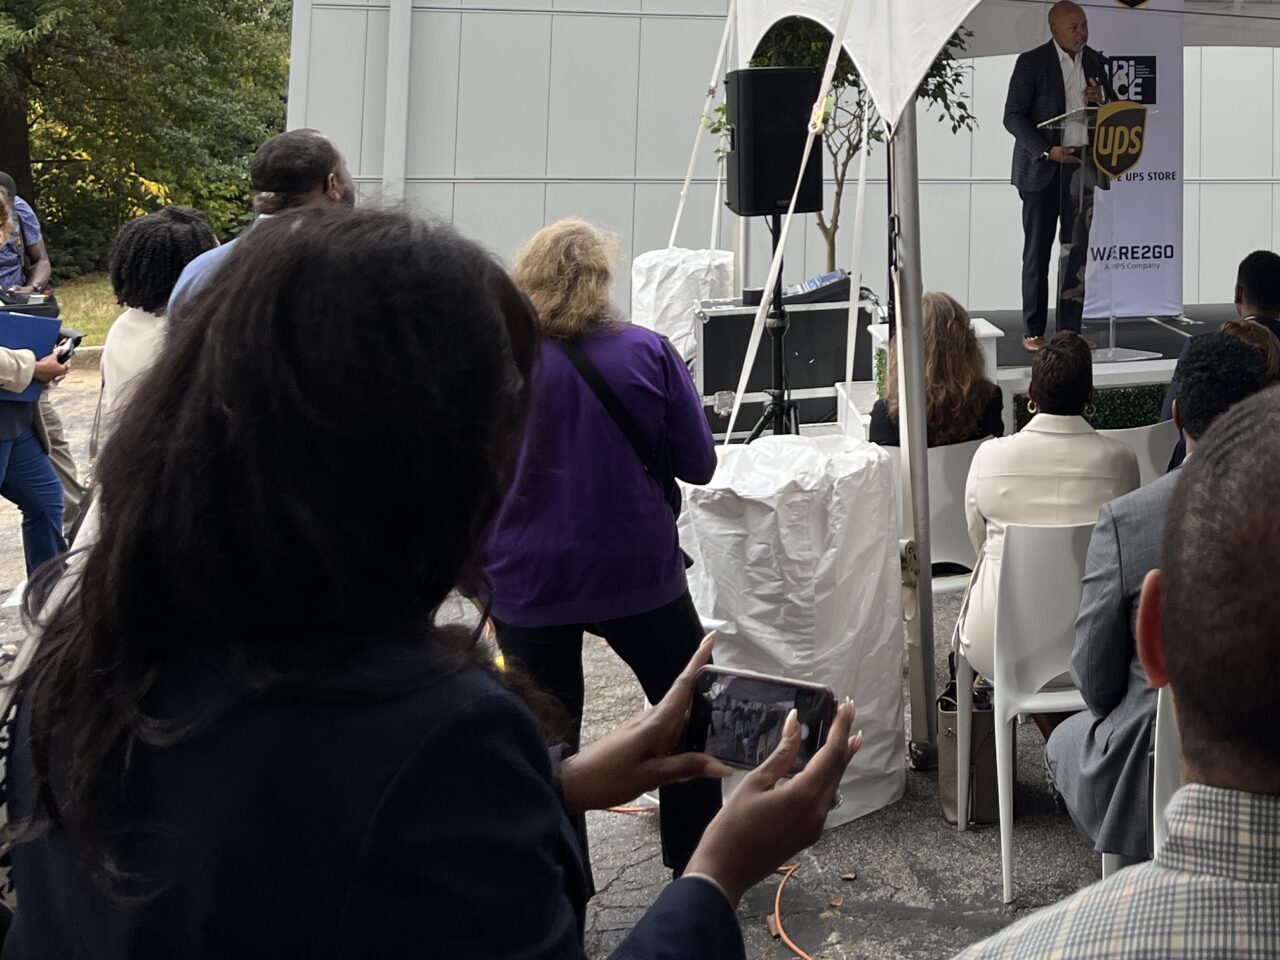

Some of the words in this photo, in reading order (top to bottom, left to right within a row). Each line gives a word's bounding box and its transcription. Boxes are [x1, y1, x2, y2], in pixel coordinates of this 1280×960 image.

[1098, 125, 1142, 166] ups
[1125, 172, 1145, 181] UPS
[1147, 171, 1177, 181] STORE
[1091, 244, 1174, 261] WARE2GO
[1112, 262, 1126, 270] PS
[1126, 262, 1160, 271] Company
